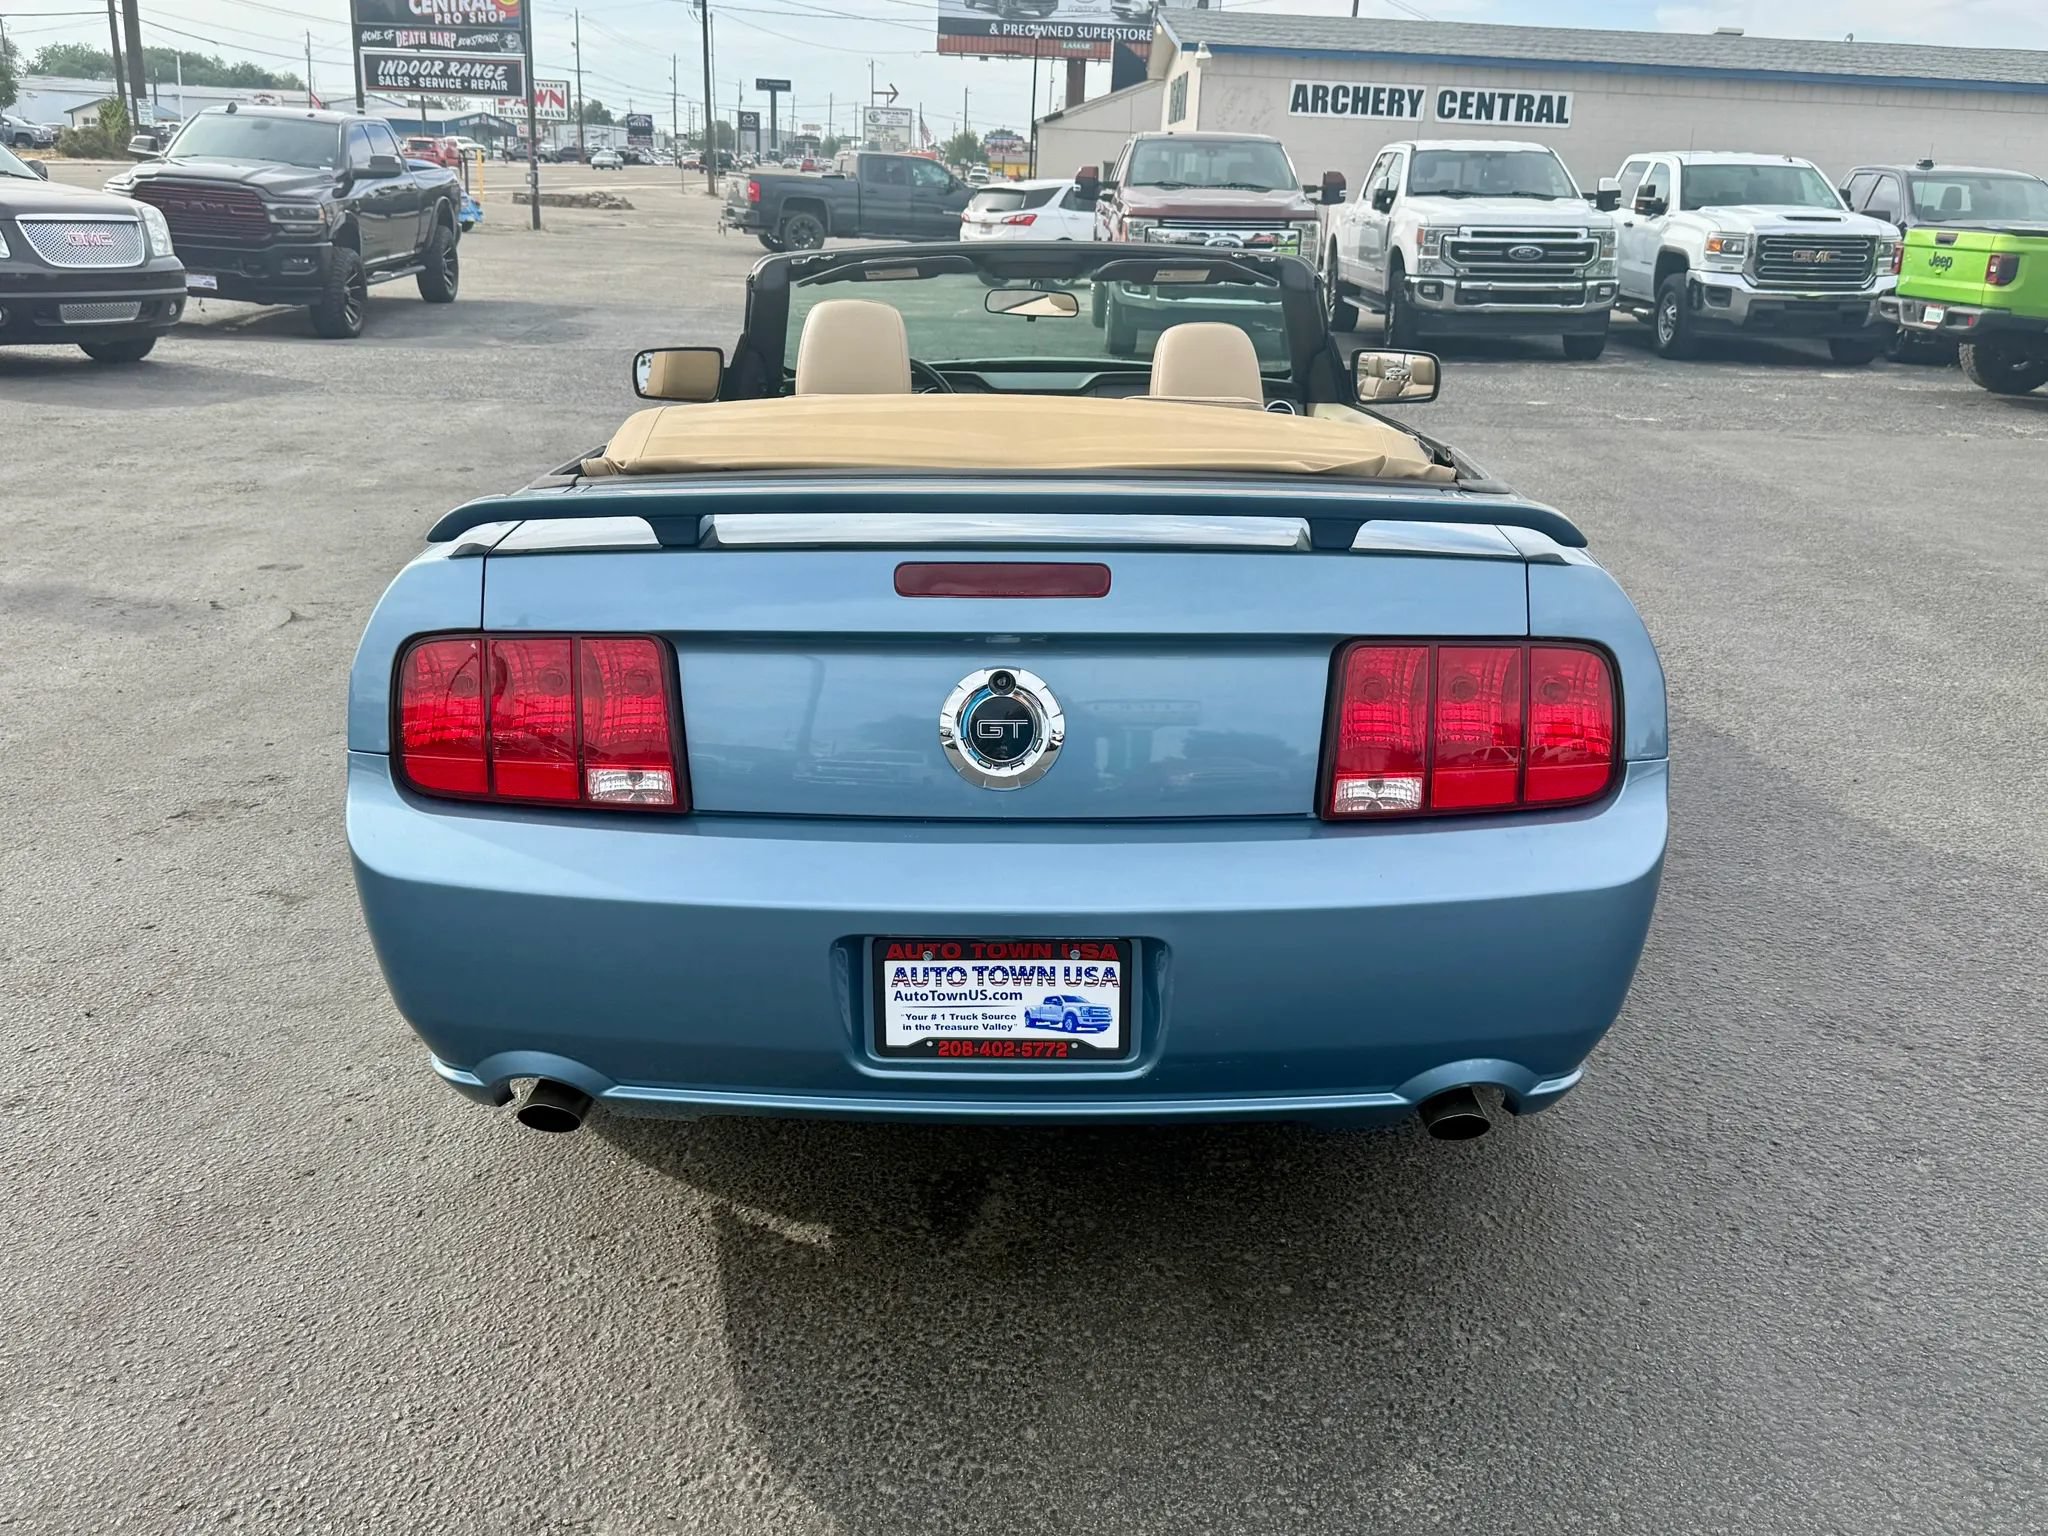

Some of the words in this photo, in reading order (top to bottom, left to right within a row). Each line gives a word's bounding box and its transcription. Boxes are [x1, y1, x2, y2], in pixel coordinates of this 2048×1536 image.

[434, 12, 462, 24] PRO
[469, 10, 506, 23] SHOP
[361, 30, 383, 43] HOME
[384, 29, 395, 40] OF
[396, 31, 427, 47] DEATH
[429, 31, 456, 49] HARP
[989, 24, 999, 35] &
[1077, 26, 1152, 42] SUPERSTORE
[377, 60, 444, 76] INDOOR
[448, 62, 507, 80] RANGE
[378, 75, 410, 87] SALES
[419, 78, 462, 89] SERVICE
[471, 80, 508, 91] REPAIR
[1290, 84, 1424, 118] ARCHERY
[1436, 90, 1569, 124] CENTRAL
[67, 231, 113, 246] GMC
[1792, 250, 1840, 263] GMC
[1928, 252, 1953, 271] Jeep
[976, 719, 1028, 739] GT
[886, 943, 962, 960] AUTO
[970, 943, 1053, 960] TOWN
[1061, 943, 1119, 960] USA
[891, 966, 968, 988] AUTO
[972, 965, 1056, 988] TOWN
[1063, 966, 1120, 988] USA
[893, 989, 1023, 1002] AutoTownUS.com
[949, 1012, 978, 1021] Truck
[981, 1012, 1017, 1021] Source
[902, 1023, 912, 1031] in
[915, 1023, 931, 1031] the
[934, 1023, 979, 1031] Treasure
[938, 1040, 1068, 1057] 208-402-5772
